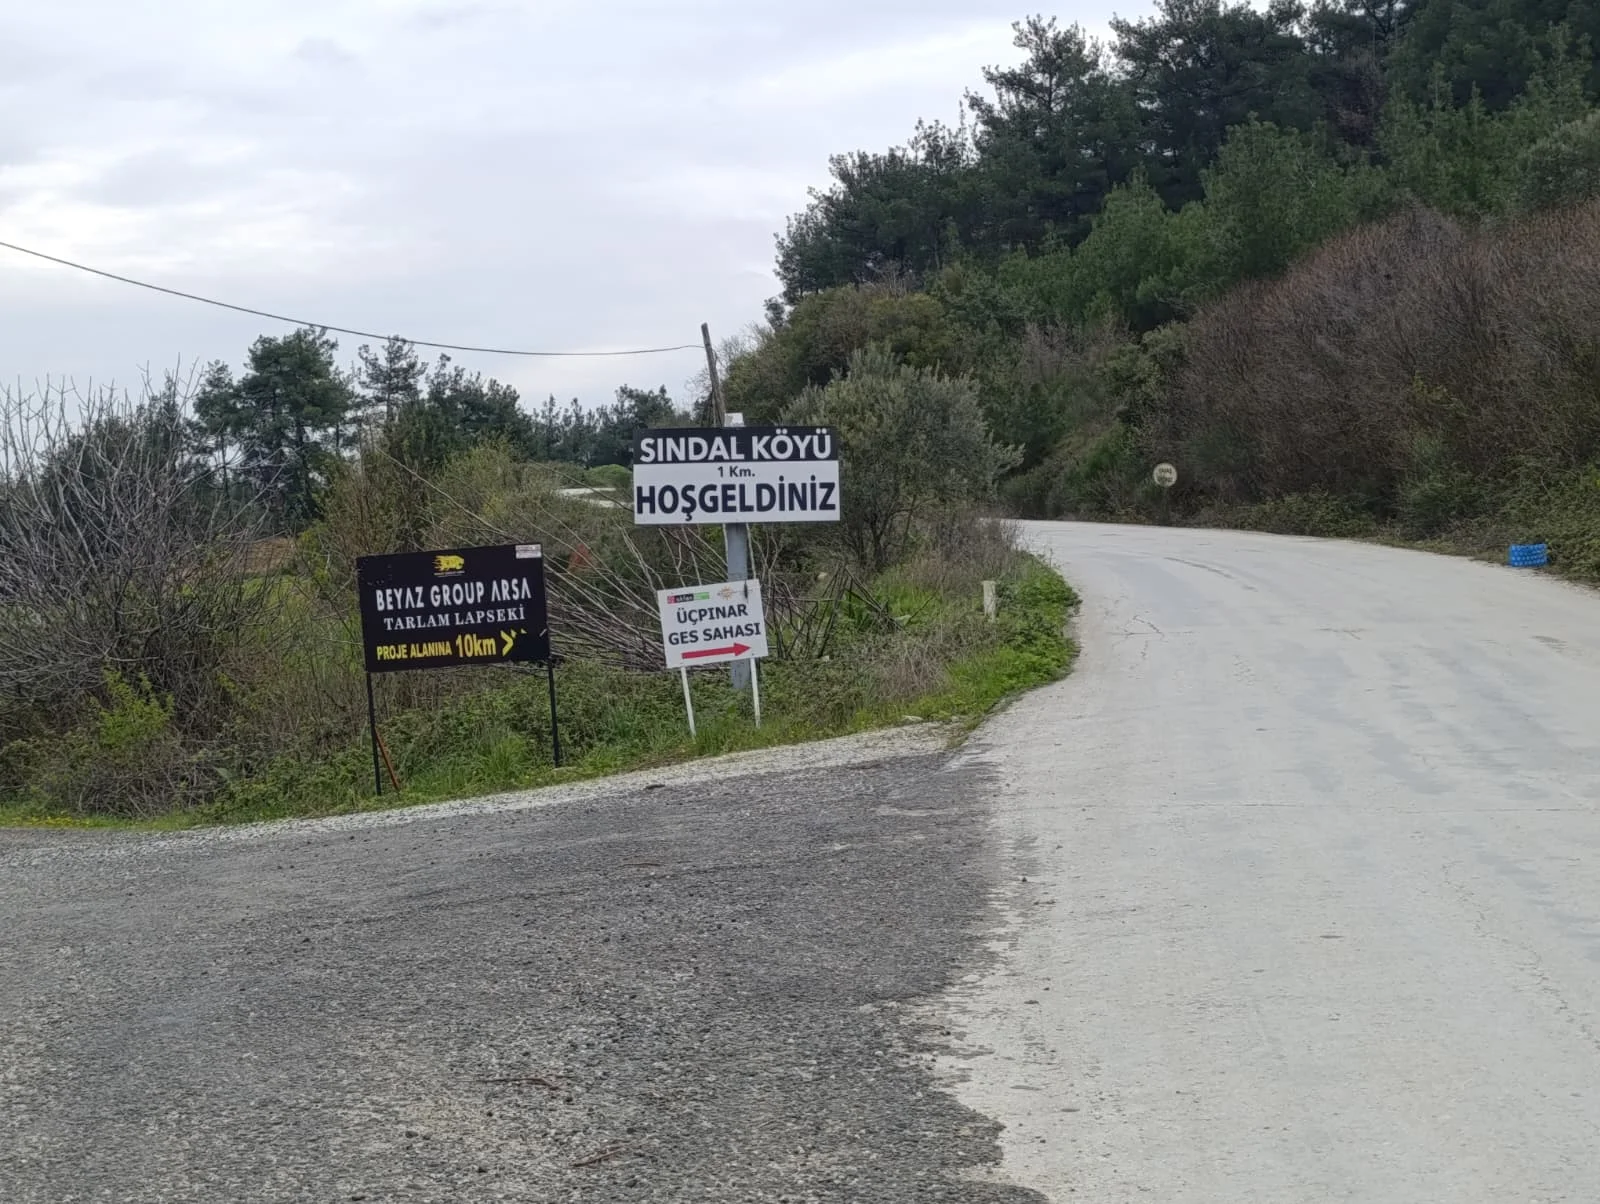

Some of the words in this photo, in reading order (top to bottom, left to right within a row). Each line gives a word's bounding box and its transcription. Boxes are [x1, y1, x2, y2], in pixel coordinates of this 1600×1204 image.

[640, 436, 745, 462] SINDAL
[752, 428, 831, 460] KÖYÜ
[717, 467, 724, 478] 1
[729, 466, 756, 478] Km.
[636, 475, 836, 521] HOŞGELDİNİZ
[376, 586, 425, 611] BEYAZ
[430, 582, 485, 608] GROUP
[491, 577, 532, 602] ARSA
[384, 613, 450, 631] TARLAM
[454, 604, 526, 626] LAPSEKİ
[676, 604, 748, 626] ÜÇPINAR
[376, 645, 408, 660] PROJE
[410, 640, 452, 658] ALANINA
[456, 633, 497, 658] 10km
[668, 630, 699, 646] GES
[702, 622, 761, 642] SAHASI
